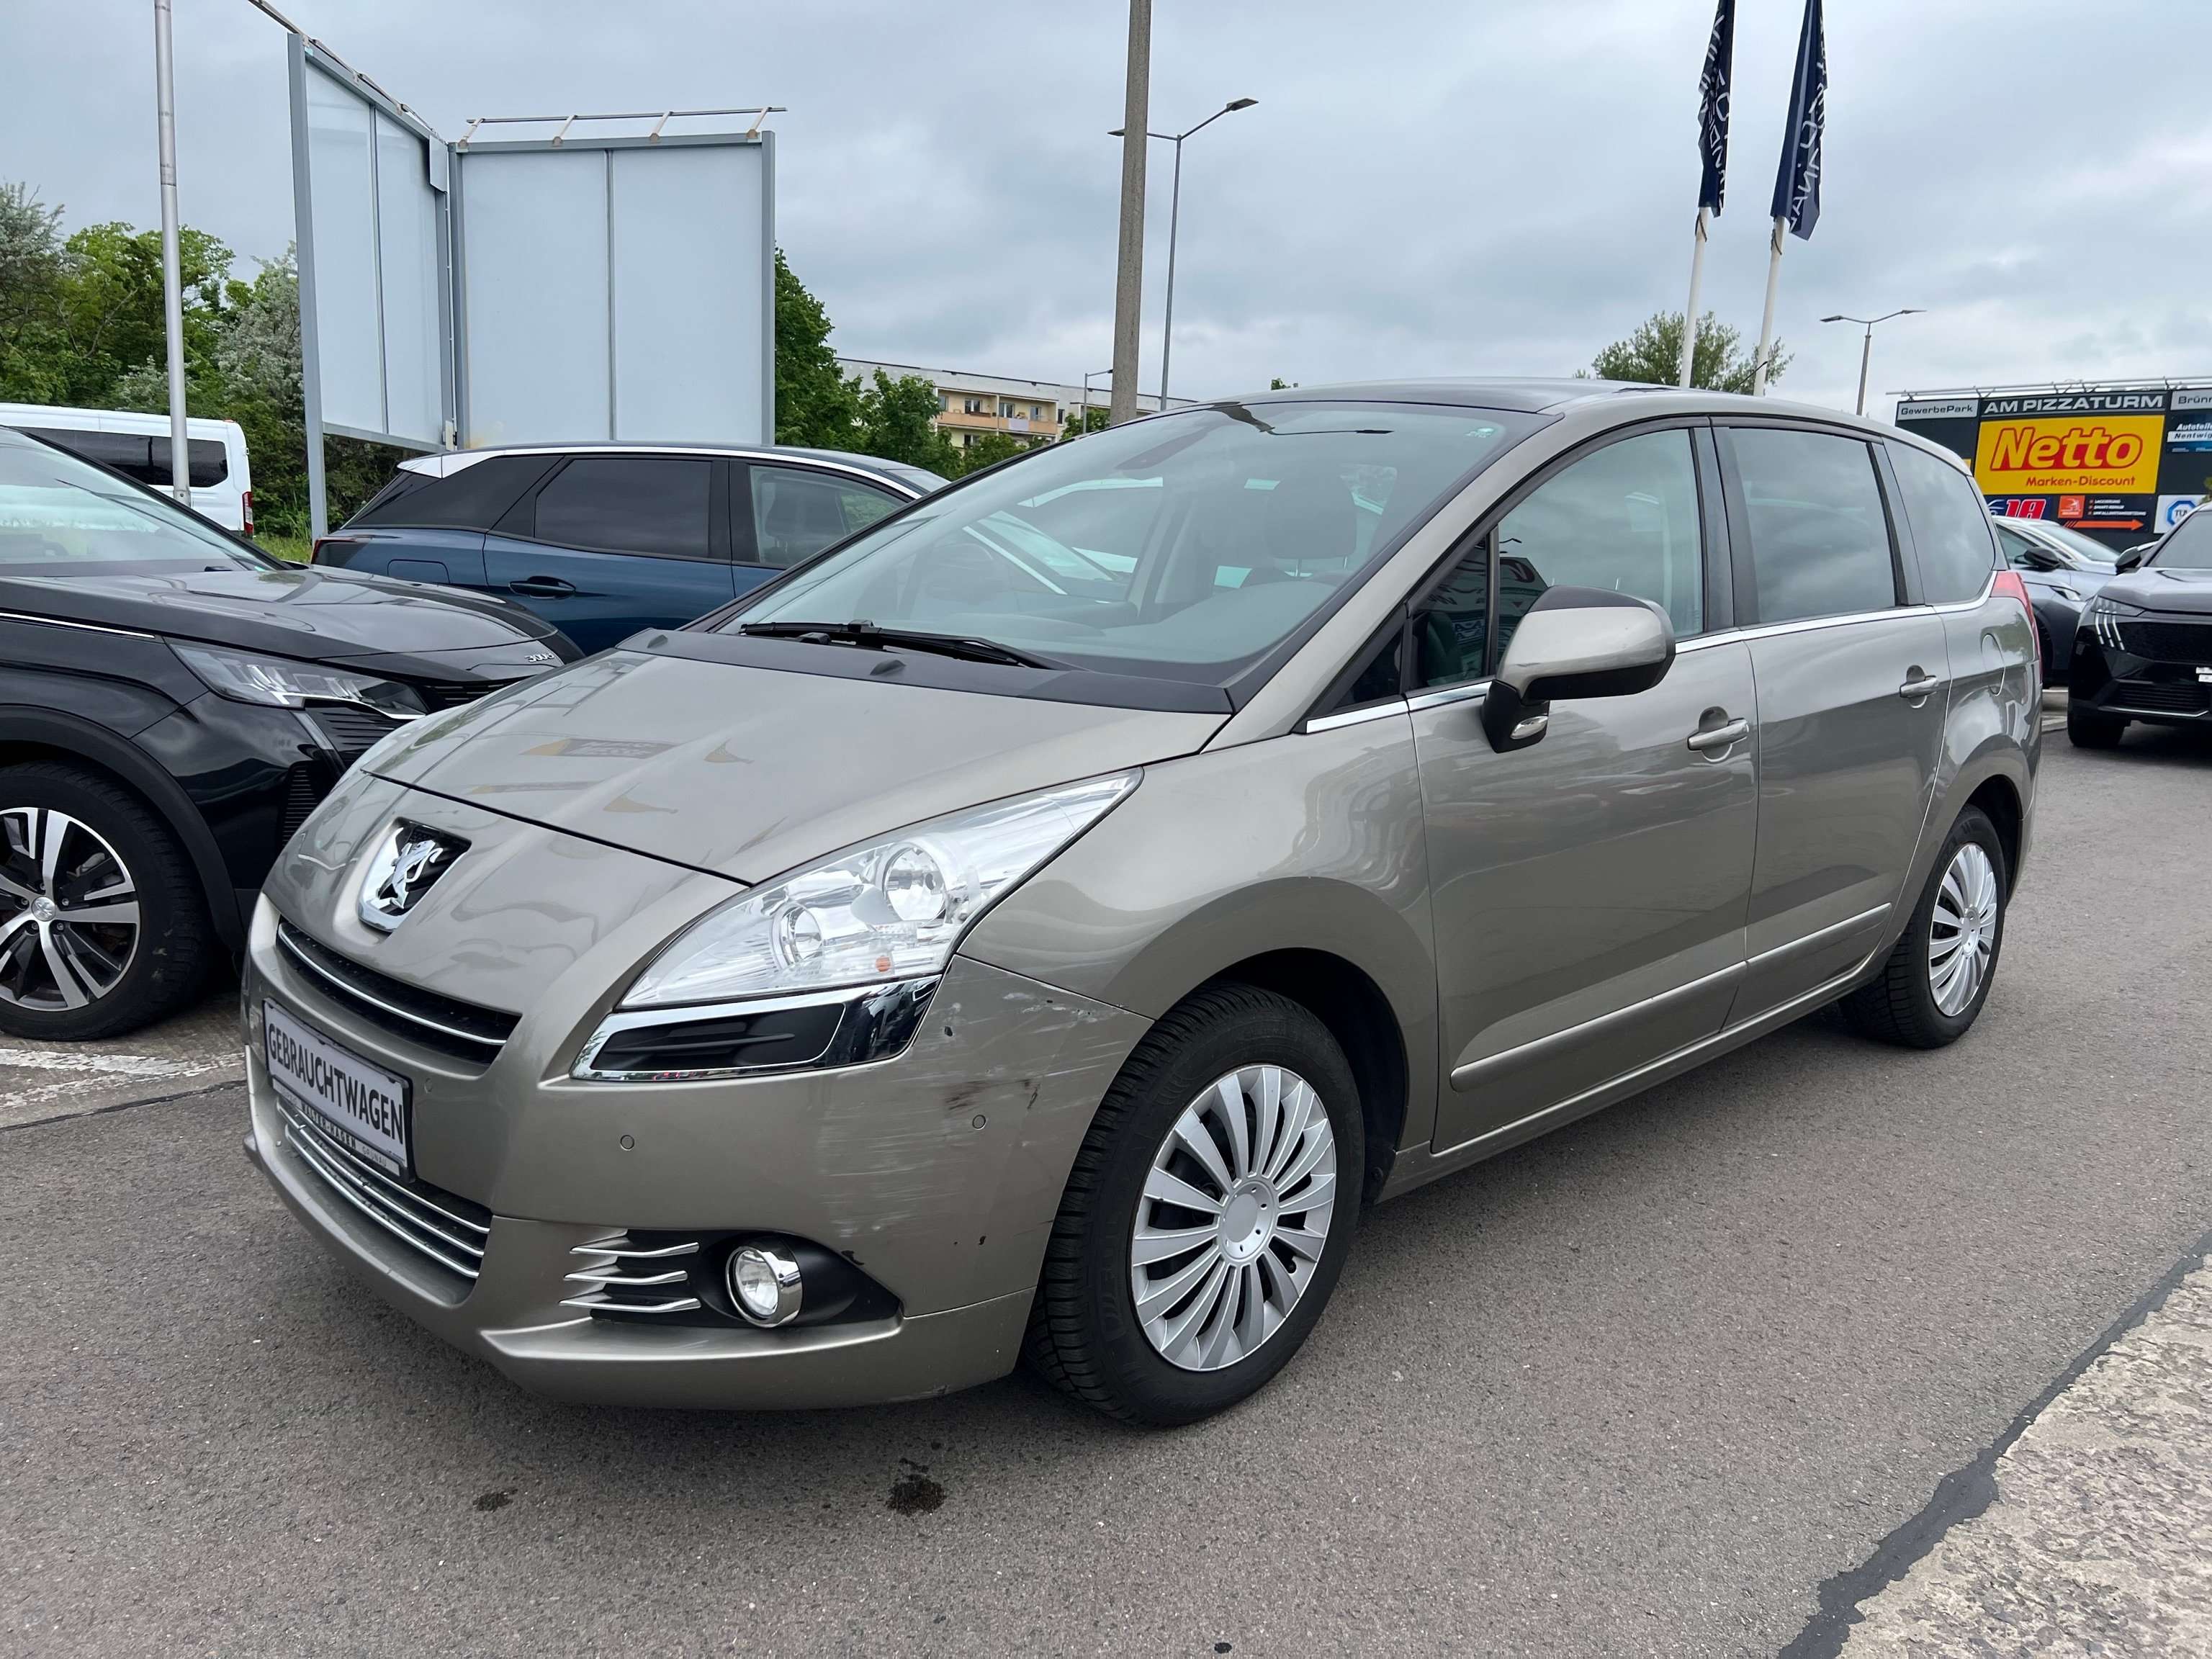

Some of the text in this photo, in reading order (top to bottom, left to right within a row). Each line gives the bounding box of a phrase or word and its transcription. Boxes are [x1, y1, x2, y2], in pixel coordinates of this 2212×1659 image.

[1901, 405, 1973, 415] GewerbePark
[1984, 395, 2163, 414] AM PIZZATURM
[1990, 426, 2143, 472] Netto
[2026, 475, 2136, 487] Marken-Discount
[268, 1022, 404, 1145] GEBRAUCHTWAGEN
